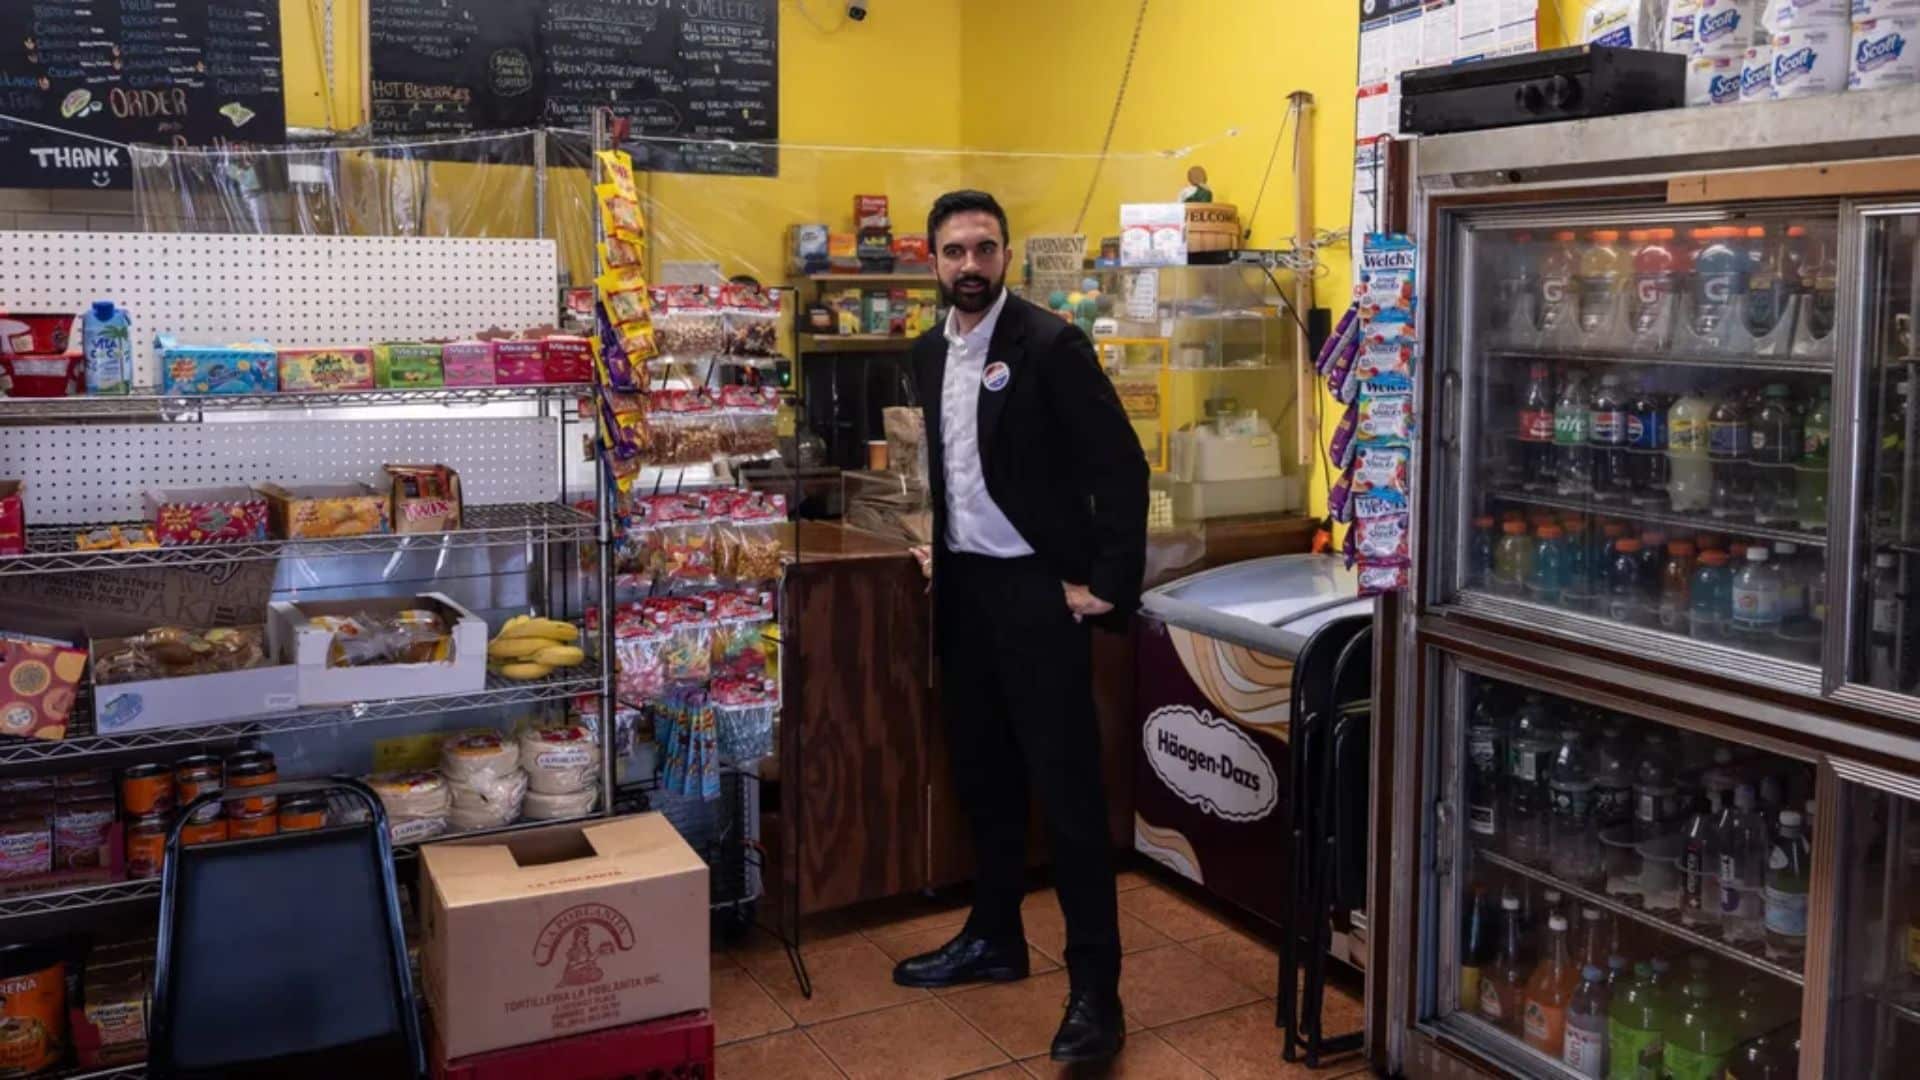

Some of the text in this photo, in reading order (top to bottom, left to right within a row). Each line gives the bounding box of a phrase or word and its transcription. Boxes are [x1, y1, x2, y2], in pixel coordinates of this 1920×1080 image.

[1703, 9, 1732, 35] Scott
[1860, 36, 1897, 62] Scott
[1776, 48, 1809, 77] Scott
[30, 147, 120, 169] THANK
[1364, 251, 1414, 268] Welch's
[402, 501, 449, 522] TWIX
[1158, 728, 1260, 792] Häagen-Dazs
